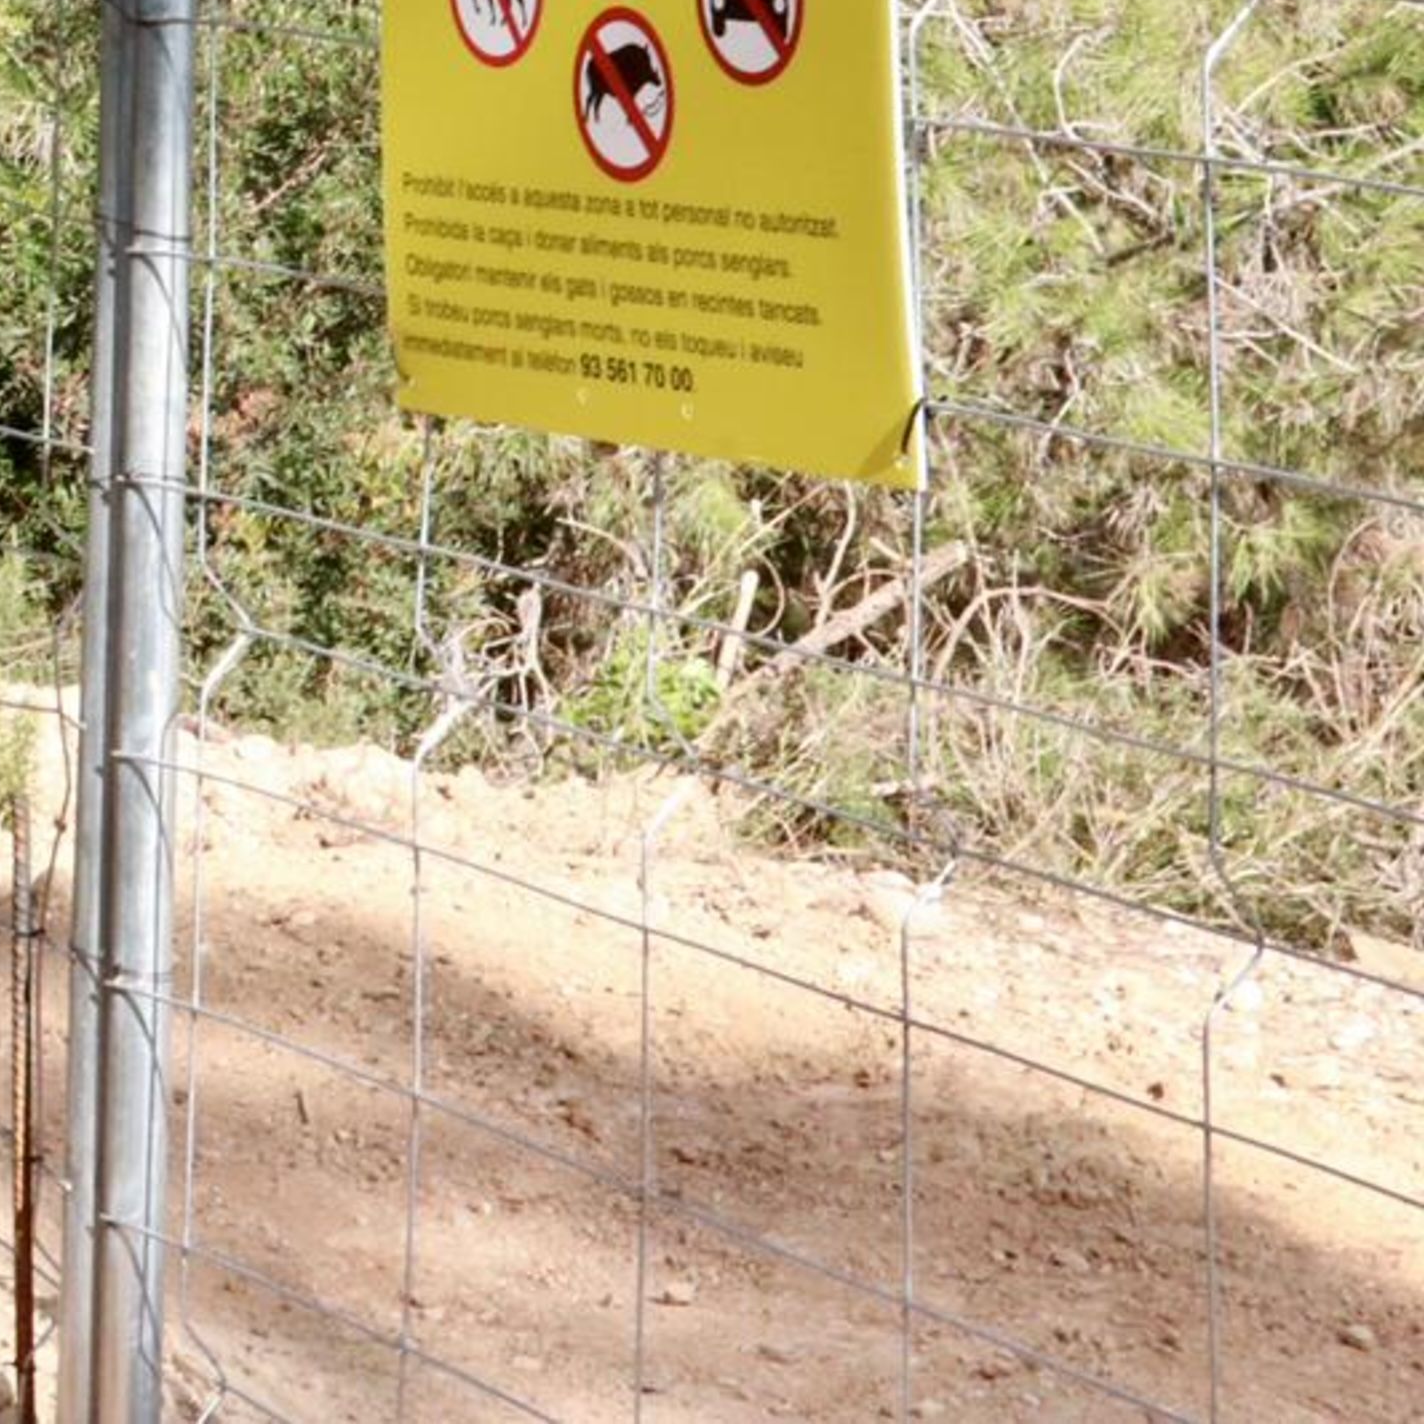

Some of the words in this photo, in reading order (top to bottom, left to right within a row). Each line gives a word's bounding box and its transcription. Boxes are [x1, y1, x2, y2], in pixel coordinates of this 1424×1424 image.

[403, 171, 454, 197] Prohibit
[510, 187, 519, 205] a
[586, 196, 621, 215] zona
[625, 200, 634, 217] a
[639, 199, 658, 219] tot
[663, 202, 730, 226] personal
[735, 210, 755, 229] no
[535, 230, 576, 253] donar
[580, 234, 642, 260] aliments
[673, 248, 716, 270] porcs
[566, 278, 597, 301] gats
[609, 283, 663, 306] gossos
[668, 290, 688, 307] en
[692, 292, 755, 318] recintes
[473, 308, 510, 328] porcs
[630, 328, 650, 347] no
[580, 353, 601, 379] 93
[606, 357, 637, 383] 561
[643, 361, 664, 388] 70
